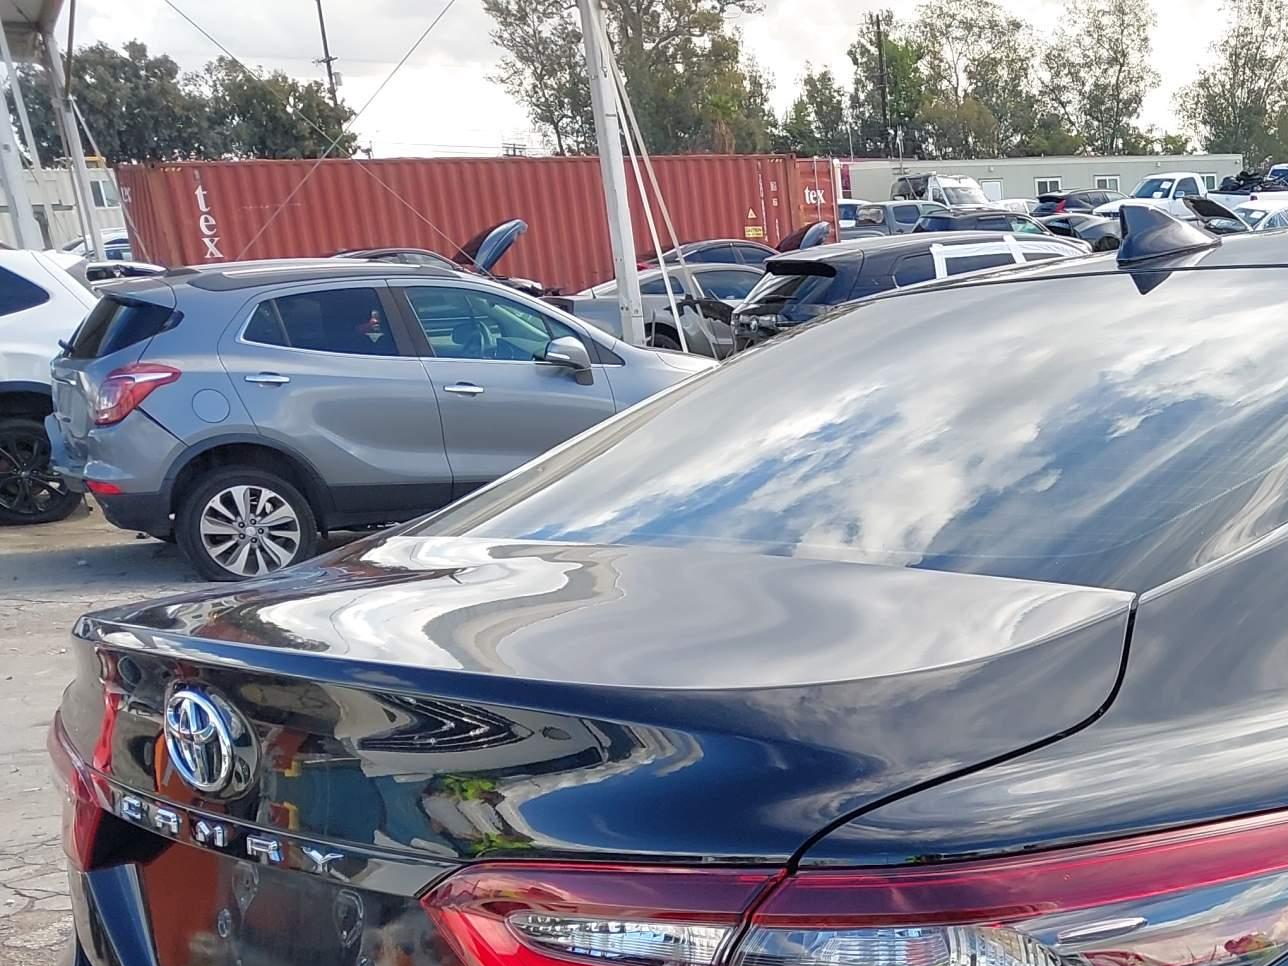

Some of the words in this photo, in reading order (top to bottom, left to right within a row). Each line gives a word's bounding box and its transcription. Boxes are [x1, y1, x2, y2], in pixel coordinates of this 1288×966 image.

[194, 184, 224, 259] tex
[804, 185, 826, 205] tex
[121, 795, 346, 876] CAMRY
